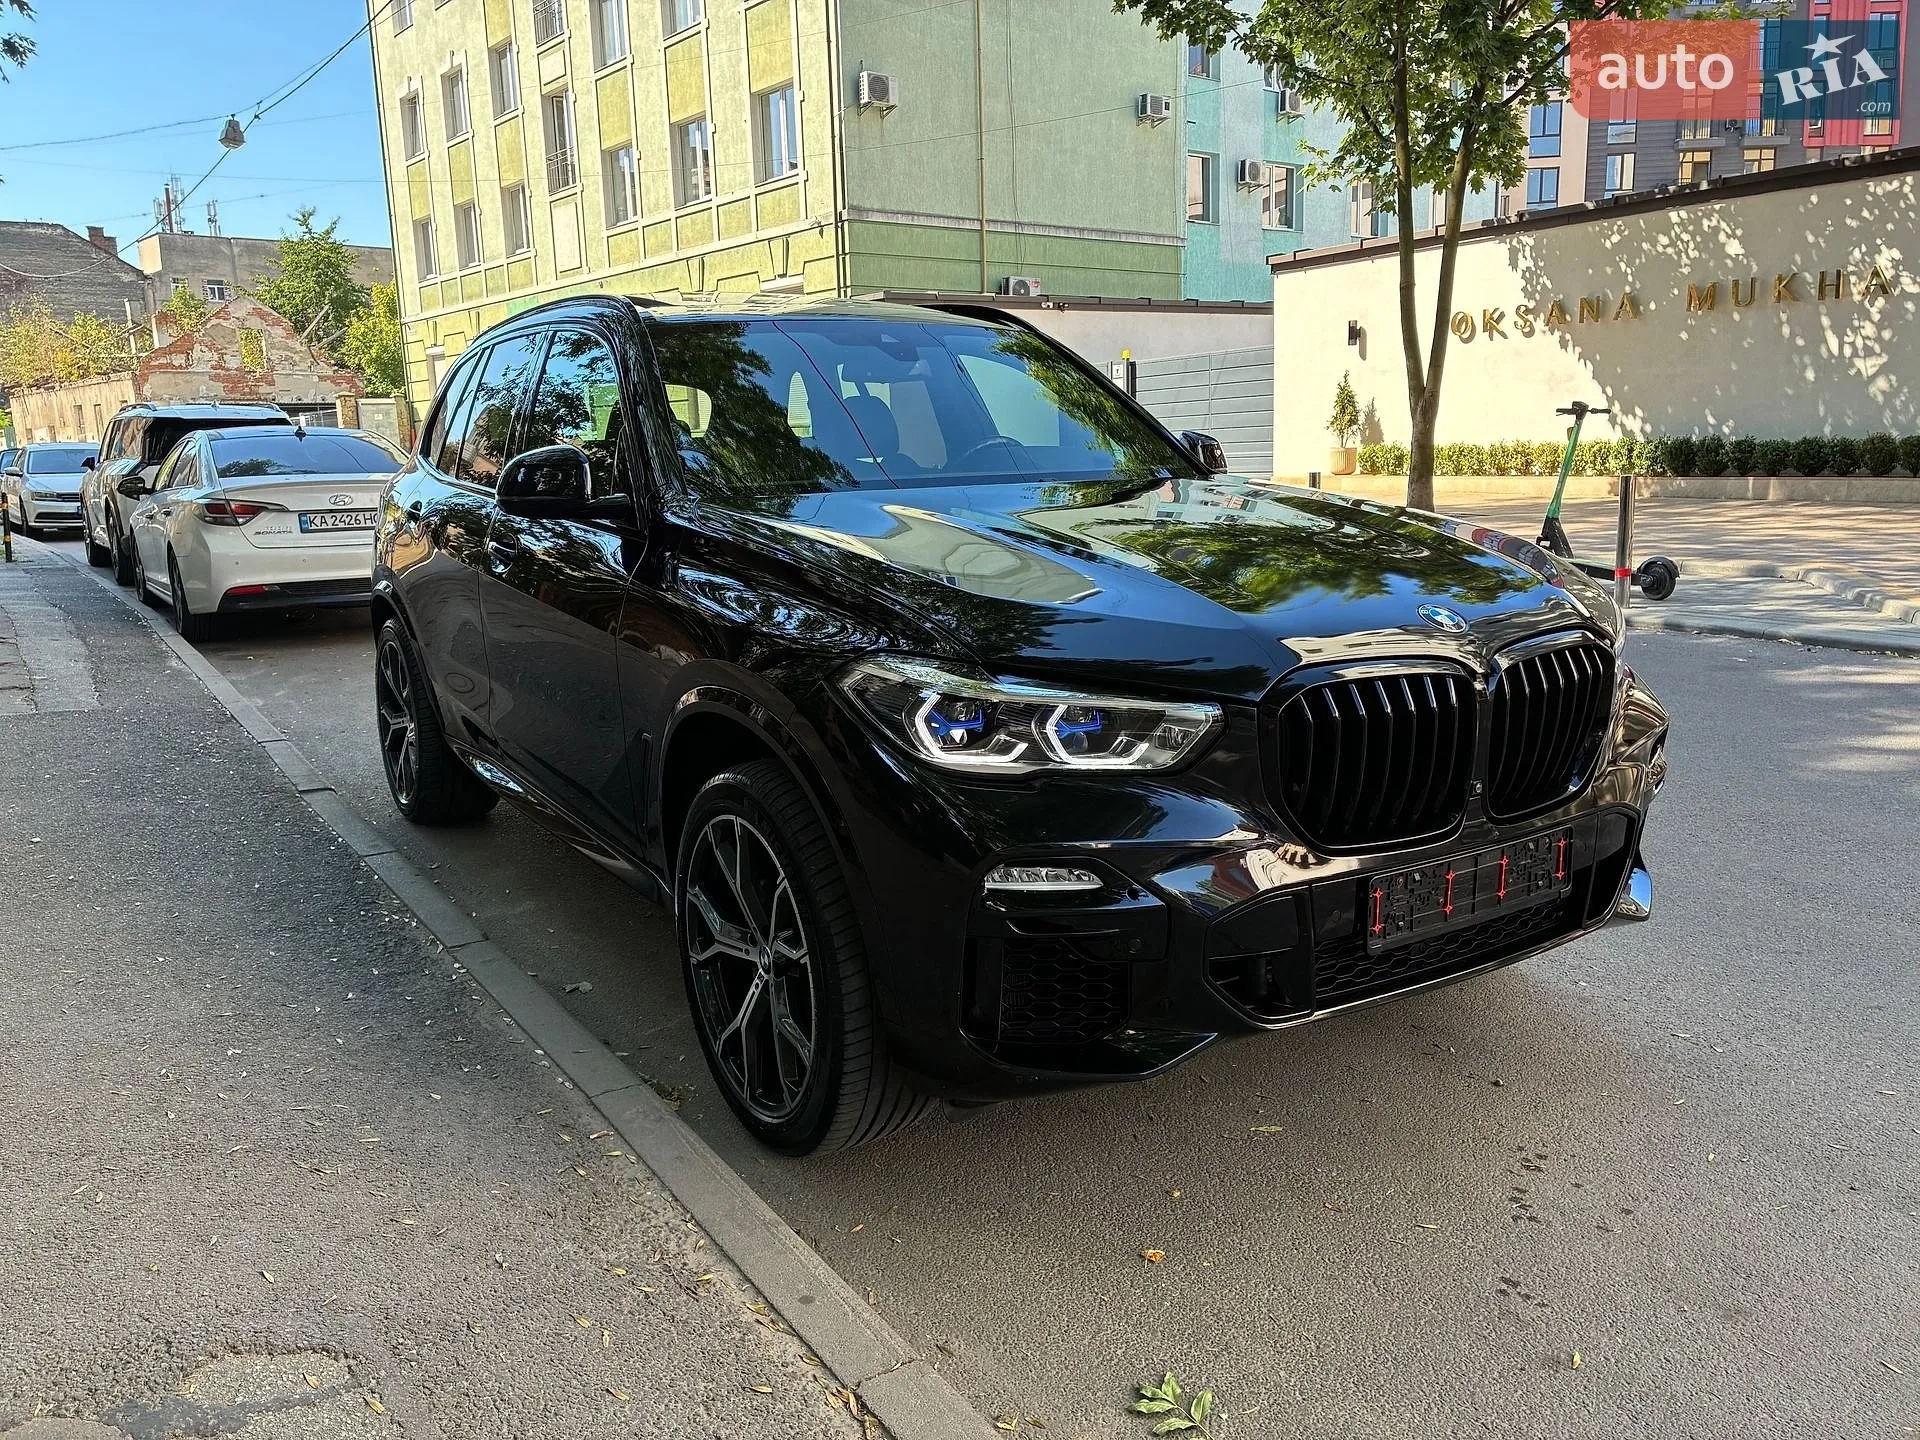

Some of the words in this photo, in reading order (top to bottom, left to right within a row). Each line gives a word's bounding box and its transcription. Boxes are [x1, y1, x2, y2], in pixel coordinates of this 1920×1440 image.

[1450, 292, 1639, 338] OKSANA
[1686, 264, 1892, 313] MUKHA
[308, 515, 329, 528] KA
[330, 514, 361, 526] 2426
